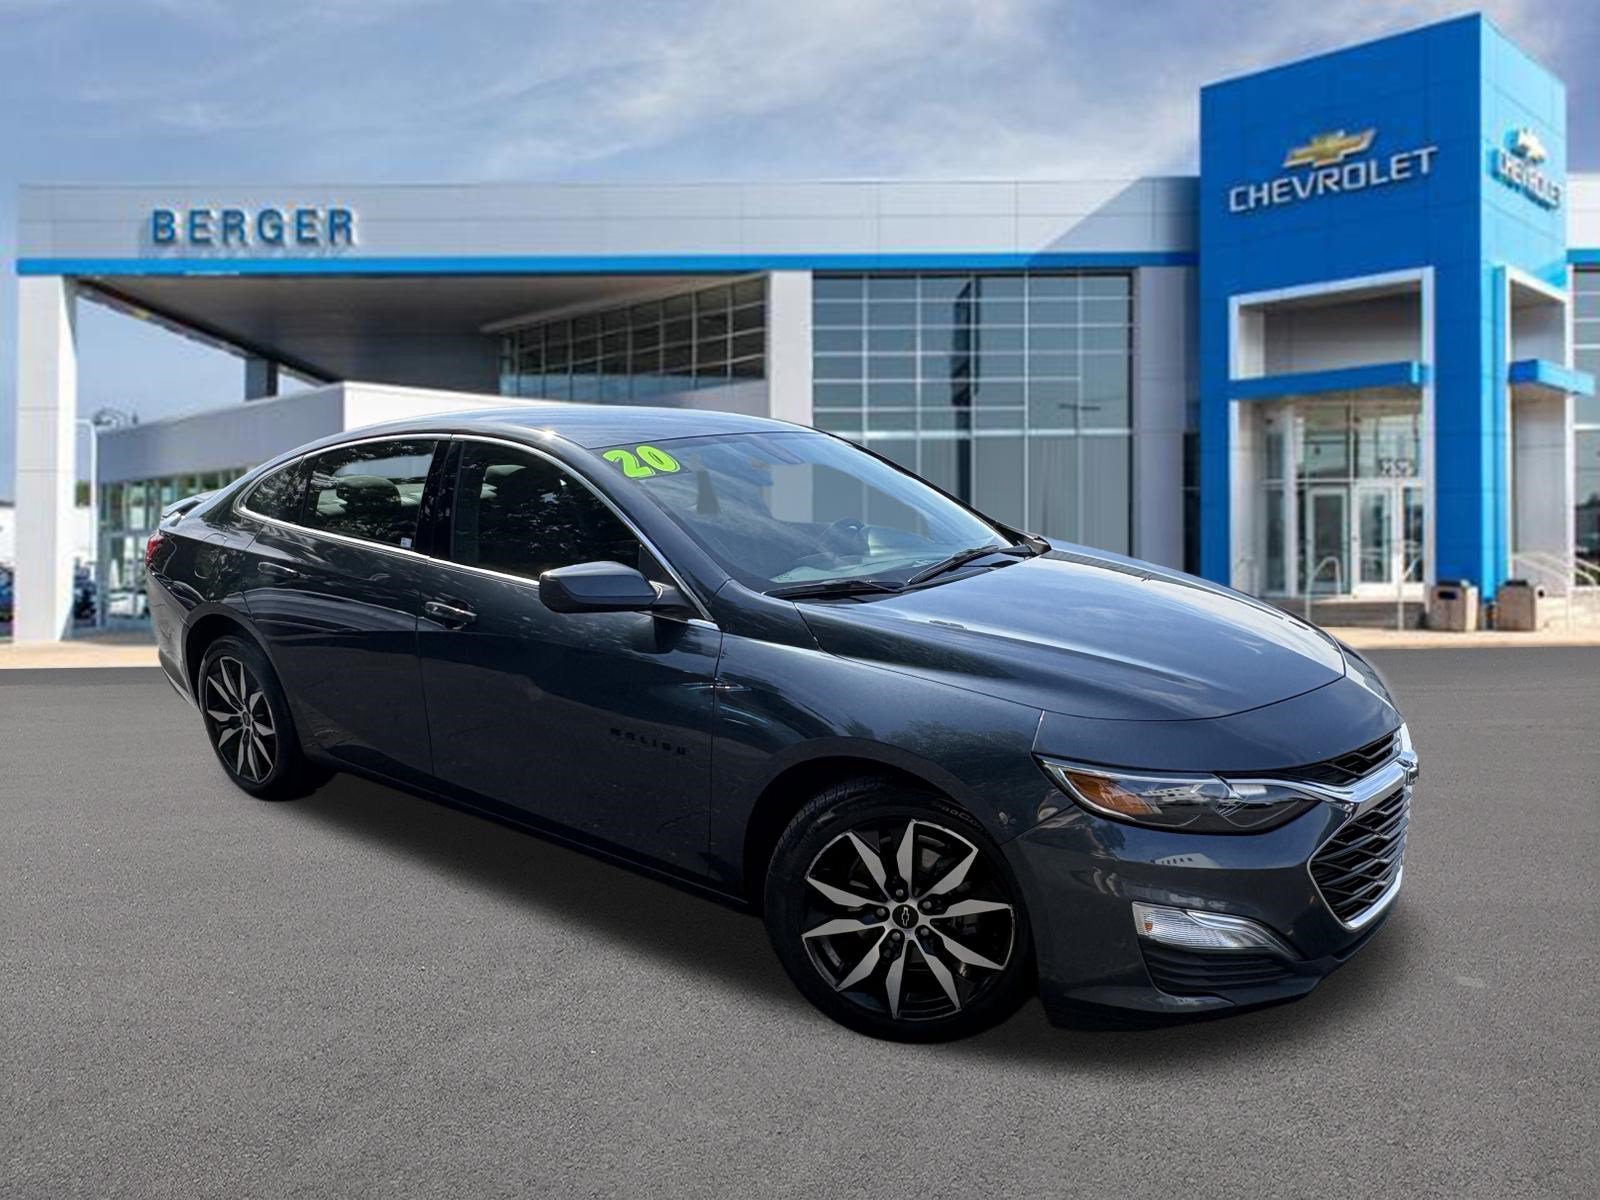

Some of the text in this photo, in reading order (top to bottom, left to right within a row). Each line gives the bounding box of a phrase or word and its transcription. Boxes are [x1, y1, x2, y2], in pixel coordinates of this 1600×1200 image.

[1228, 145, 1439, 212] CHEVROLET
[152, 207, 355, 246] BERGER
[602, 445, 681, 478] 20
